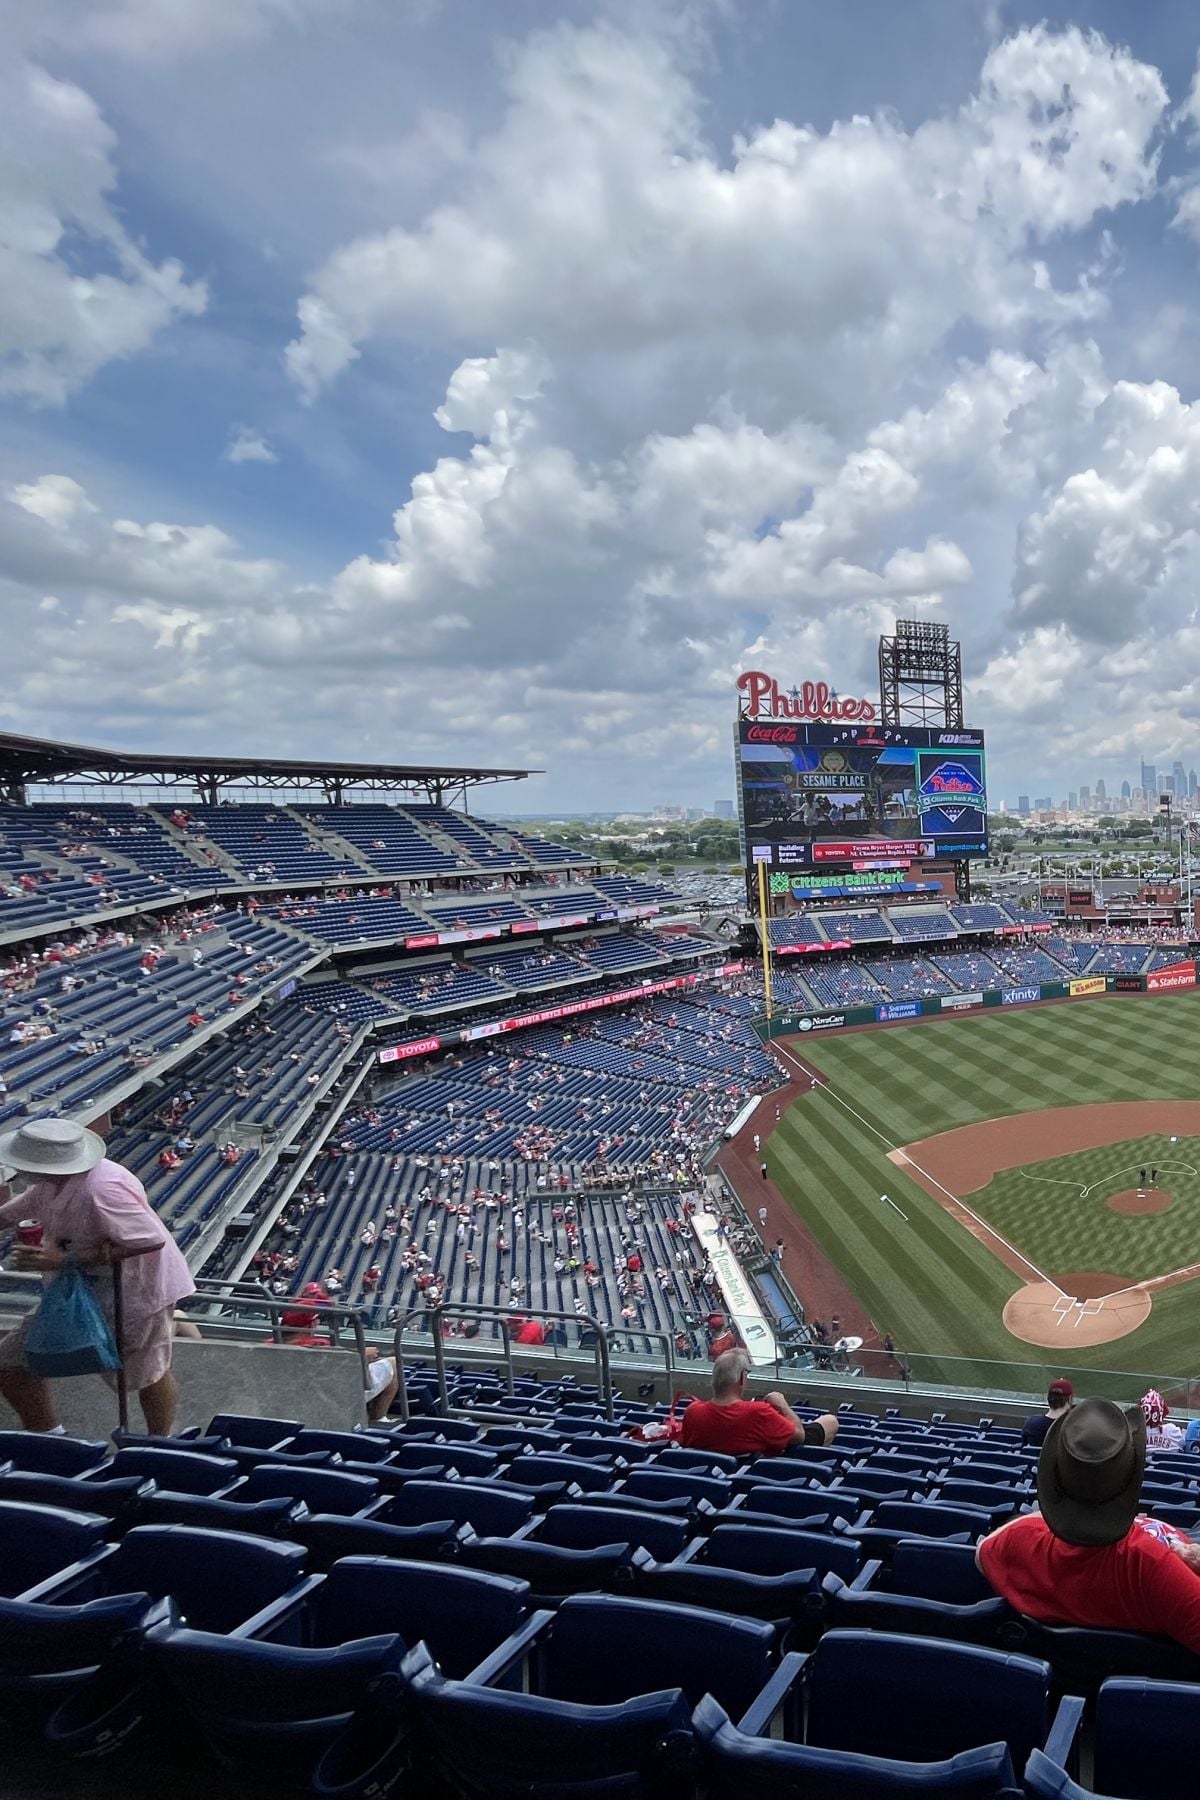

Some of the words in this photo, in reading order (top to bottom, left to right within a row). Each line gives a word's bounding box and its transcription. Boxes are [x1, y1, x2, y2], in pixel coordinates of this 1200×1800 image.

[737, 671, 876, 720] Phillies
[748, 725, 798, 742] Coca-Cola
[803, 774, 837, 787] SESAME
[840, 775, 866, 787] PLACE
[791, 876, 844, 888] Citizens
[845, 872, 876, 886] Bank
[878, 871, 905, 883] Park
[1004, 989, 1038, 1003] xfinity
[515, 1013, 541, 1027] TOYOTA
[812, 1016, 844, 1026] NovaCare
[400, 1040, 438, 1056] TOYOTA
